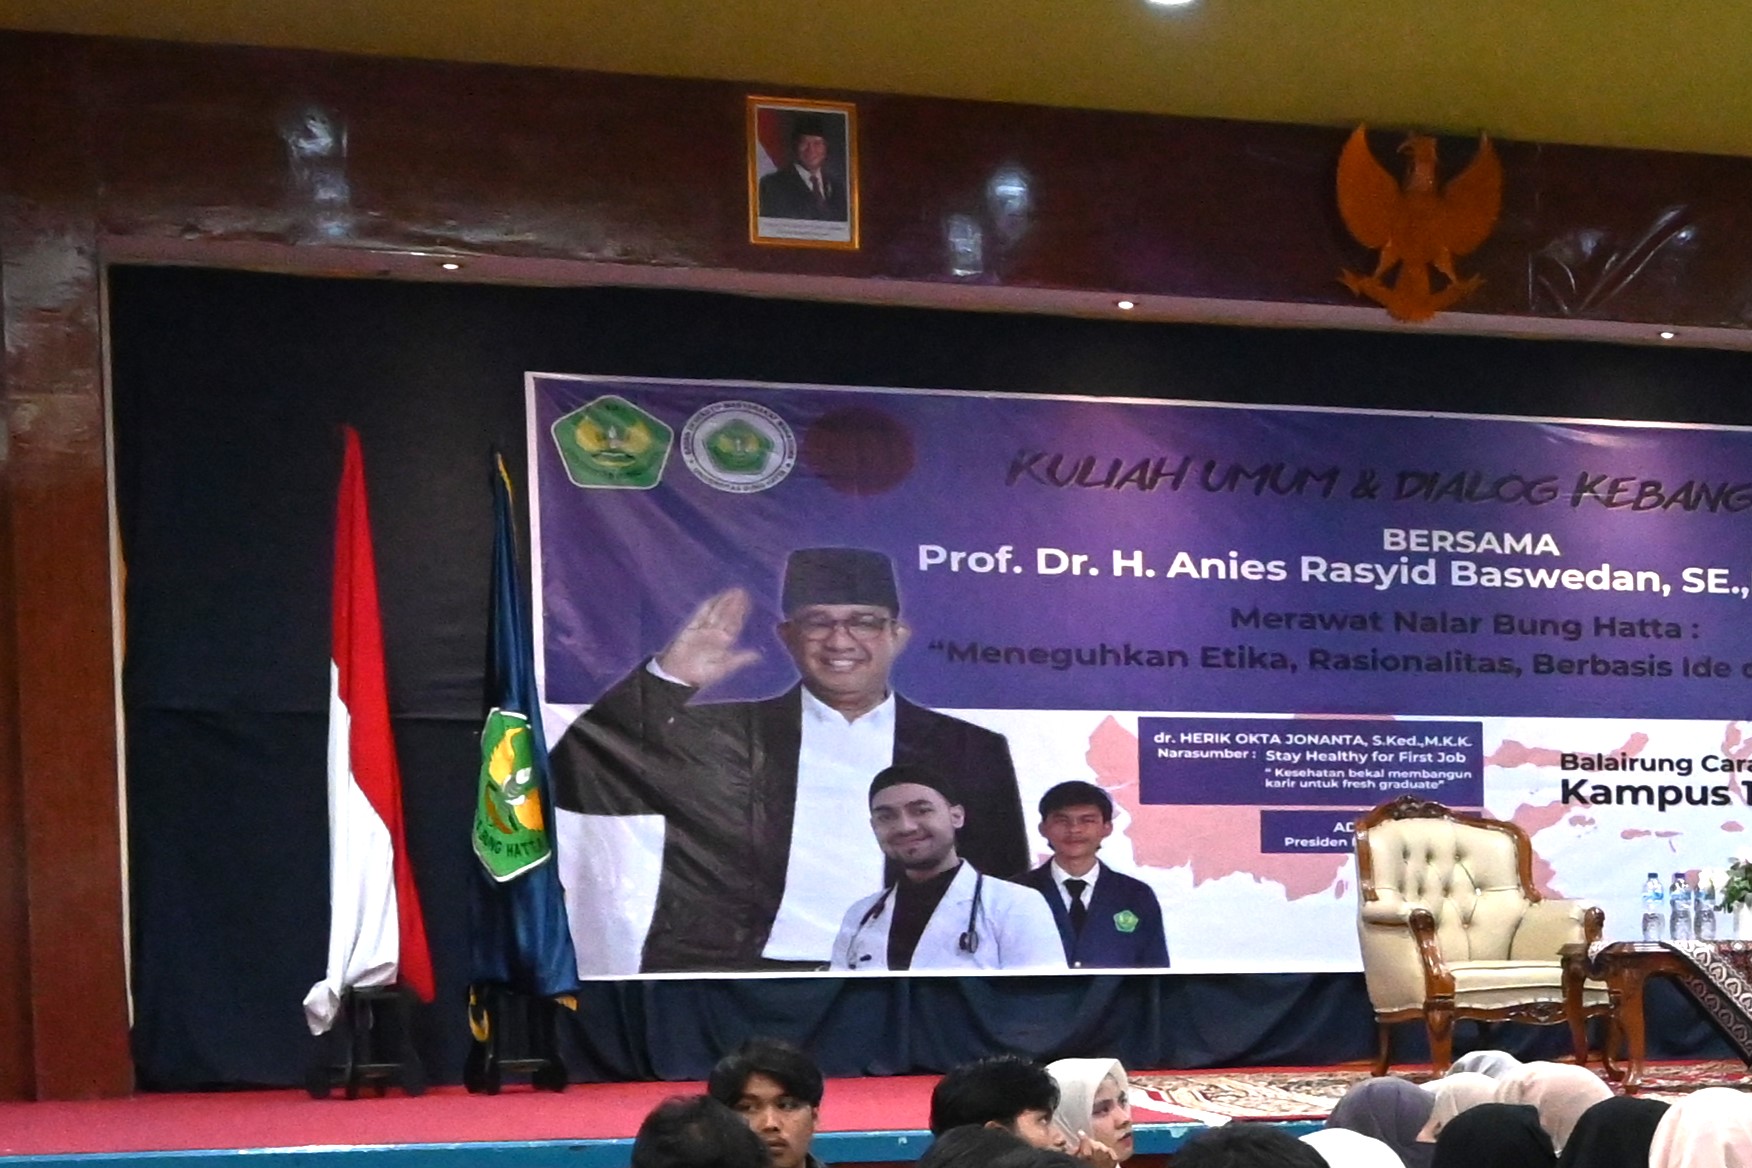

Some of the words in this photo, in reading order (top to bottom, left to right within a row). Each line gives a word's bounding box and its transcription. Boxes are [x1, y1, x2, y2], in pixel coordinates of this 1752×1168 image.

[1004, 449, 1192, 491] KULIAH
[1202, 458, 1340, 498] UMUM
[1351, 469, 1378, 499] &
[1396, 470, 1560, 505] DIALOG
[1383, 528, 1561, 557] BERSAMA
[918, 544, 1023, 574] Prof.
[1036, 547, 1099, 576] Dr.
[1112, 549, 1156, 578] H.
[1166, 550, 1288, 582] Anies
[1300, 555, 1437, 591] Rasyid
[1450, 560, 1672, 598] Baswedan,
[1231, 607, 1384, 632] Merawat
[1393, 610, 1483, 634] Nalar
[1493, 613, 1583, 642] Bung
[1593, 615, 1682, 640] Hatta
[1200, 644, 1298, 674] Etika,
[1308, 648, 1523, 678] Rasionalitas,
[1532, 653, 1674, 678] Berbasis
[1682, 655, 1732, 679] Ide
[1153, 731, 1176, 744] dr.
[1180, 732, 1231, 744] HERIK
[1234, 733, 1282, 745] OKTA
[1285, 734, 1369, 748] JONANTA,
[1157, 747, 1249, 760] Narasumber
[1265, 750, 1302, 764] Stay
[1305, 750, 1369, 765] Healthy
[1371, 751, 1395, 763] for
[1398, 752, 1434, 764] First
[1436, 752, 1467, 764] Job
[1560, 752, 1693, 777] Balairung
[1264, 778, 1297, 788] karir
[1299, 778, 1339, 789] untuk
[1342, 779, 1377, 790] fresh
[1274, 767, 1346, 778] Kesehatan
[1348, 768, 1385, 779] bekal
[1387, 769, 1473, 781] membangun
[1561, 778, 1732, 812] Kampus
[1284, 836, 1348, 847] Presiden
